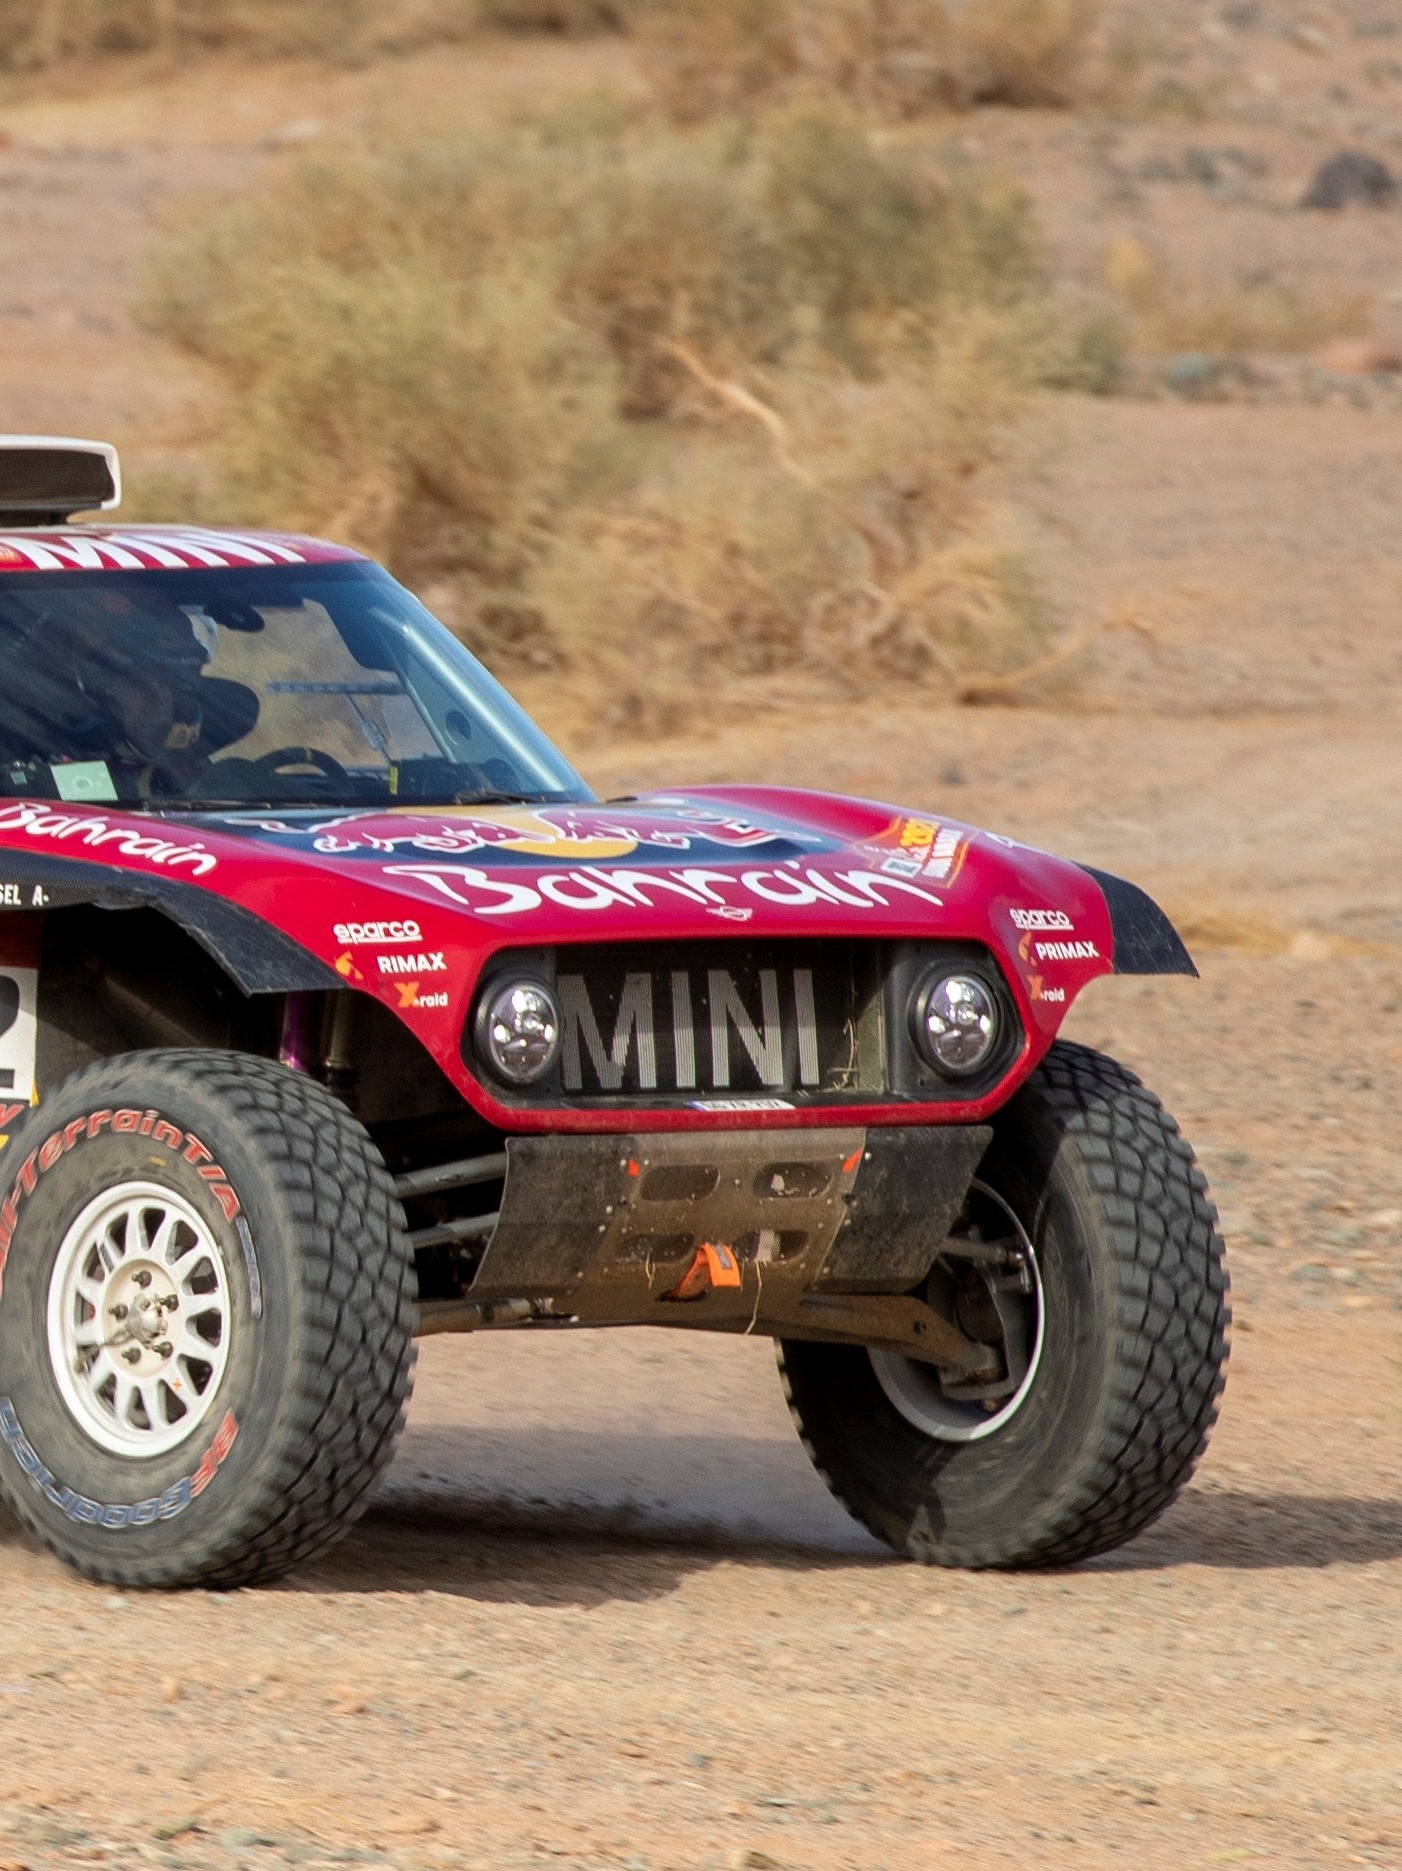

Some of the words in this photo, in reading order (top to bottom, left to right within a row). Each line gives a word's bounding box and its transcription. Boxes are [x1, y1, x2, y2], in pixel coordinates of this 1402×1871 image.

[381, 861, 944, 915] Bahrain
[1009, 908, 1075, 931] sparco
[333, 920, 423, 944] sparco
[1035, 941, 1100, 960] PRIMAX
[377, 952, 447, 973] RIMAX
[557, 969, 819, 1089] MINI
